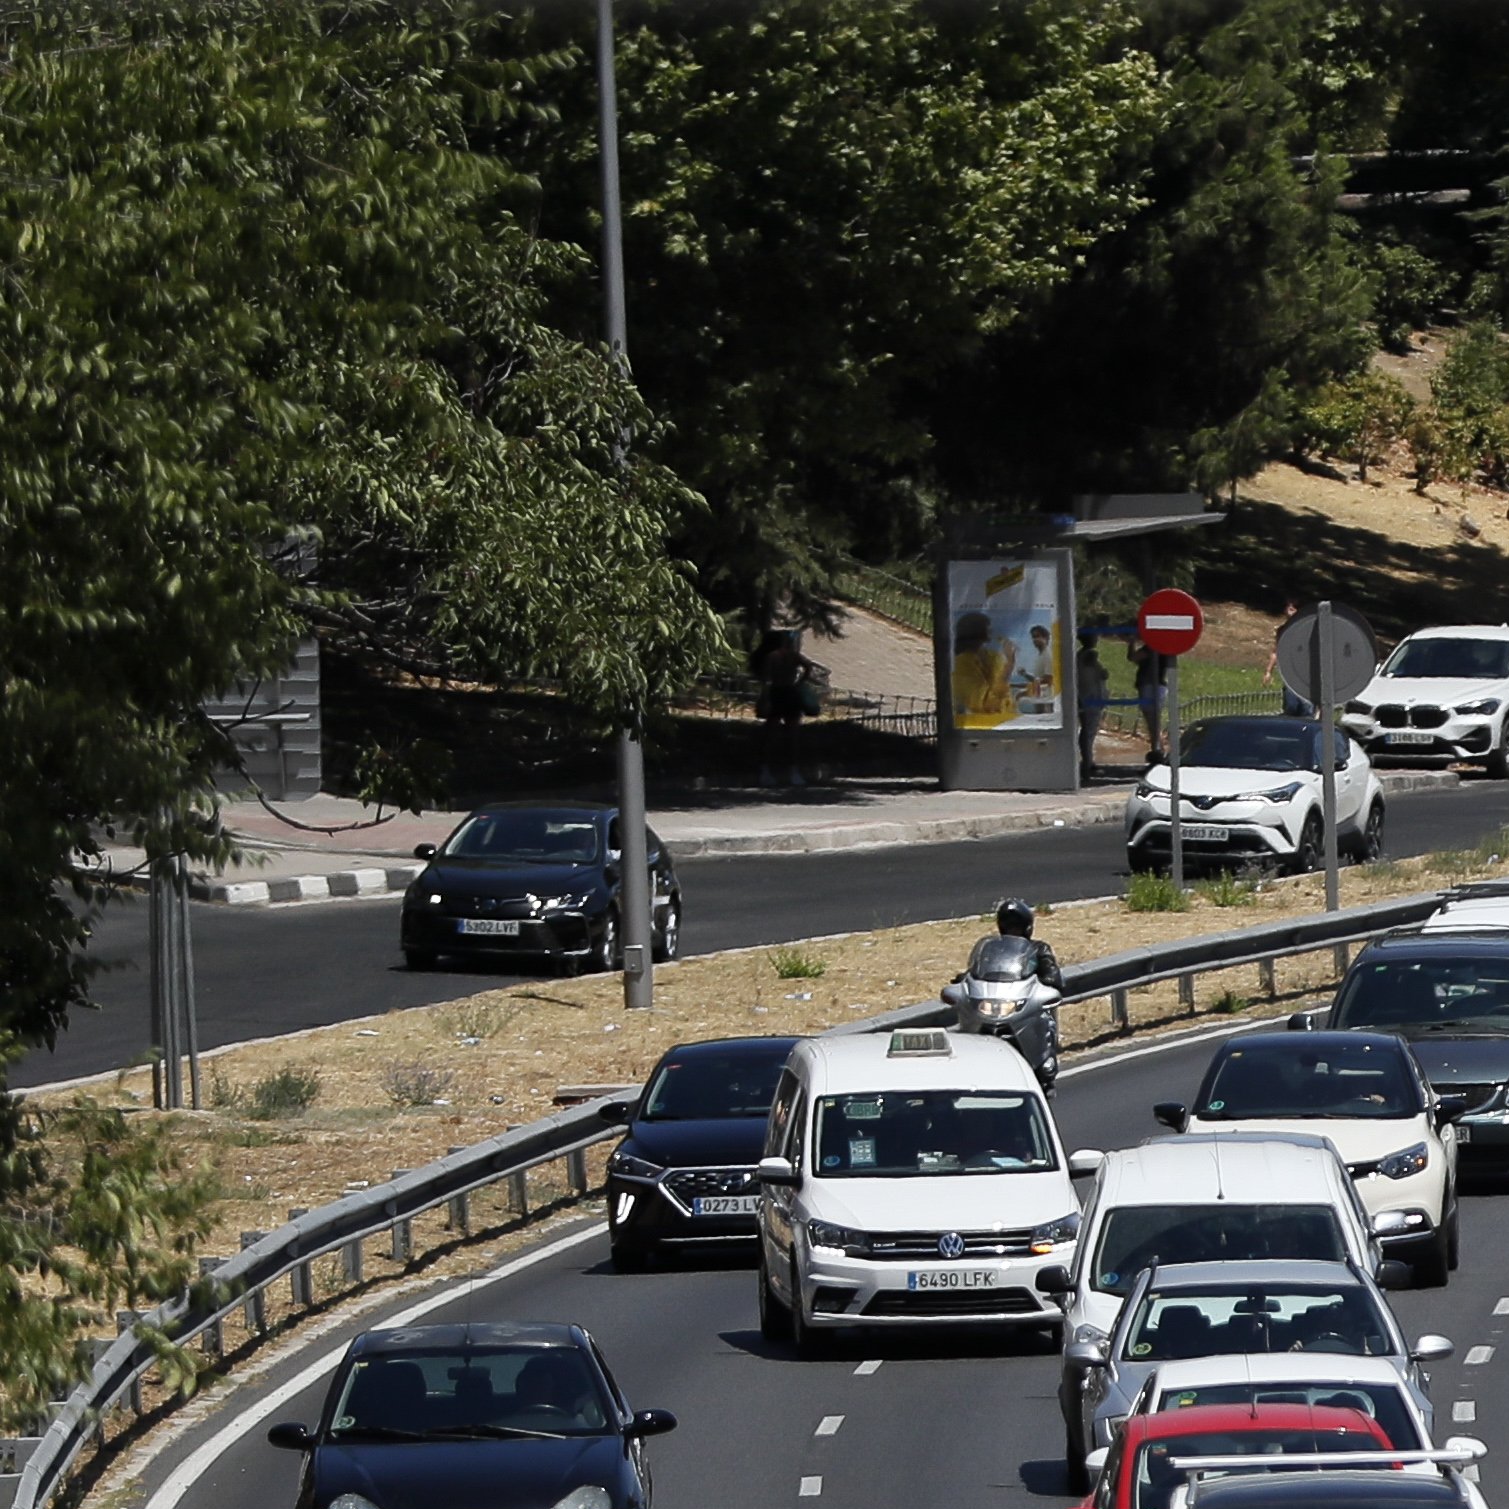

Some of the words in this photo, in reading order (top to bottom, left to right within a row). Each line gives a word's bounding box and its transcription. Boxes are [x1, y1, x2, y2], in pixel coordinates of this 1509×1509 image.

[903, 1035, 930, 1050] TAXI
[704, 1199, 739, 1213] 0273
[919, 1274, 957, 1288] 6490
[963, 1272, 993, 1287] LFK
